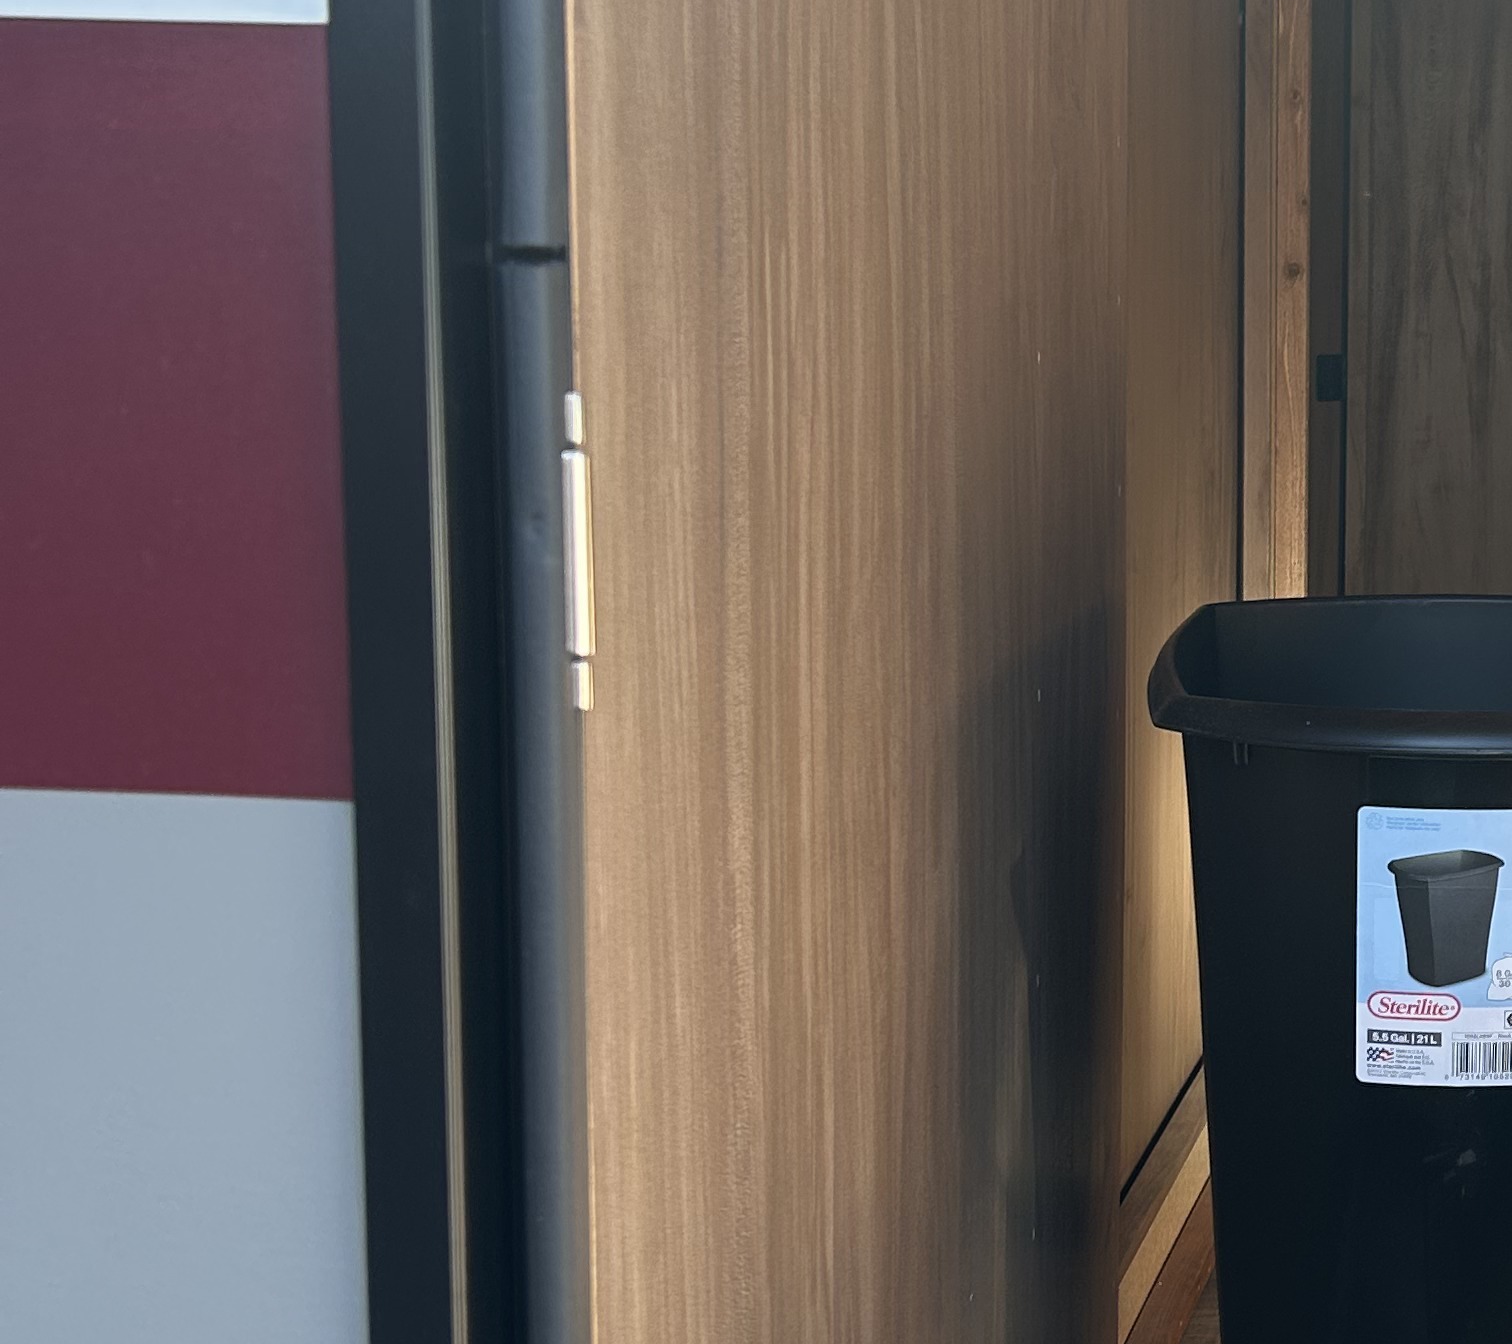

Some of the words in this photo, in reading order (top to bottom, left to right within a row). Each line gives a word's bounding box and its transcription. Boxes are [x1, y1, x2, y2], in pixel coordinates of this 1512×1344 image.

[1377, 996, 1451, 1017] Sterilite
[1372, 1031, 1389, 1042] 5.5
[1416, 1034, 1429, 1045] 21
[1430, 1034, 1438, 1045] L
